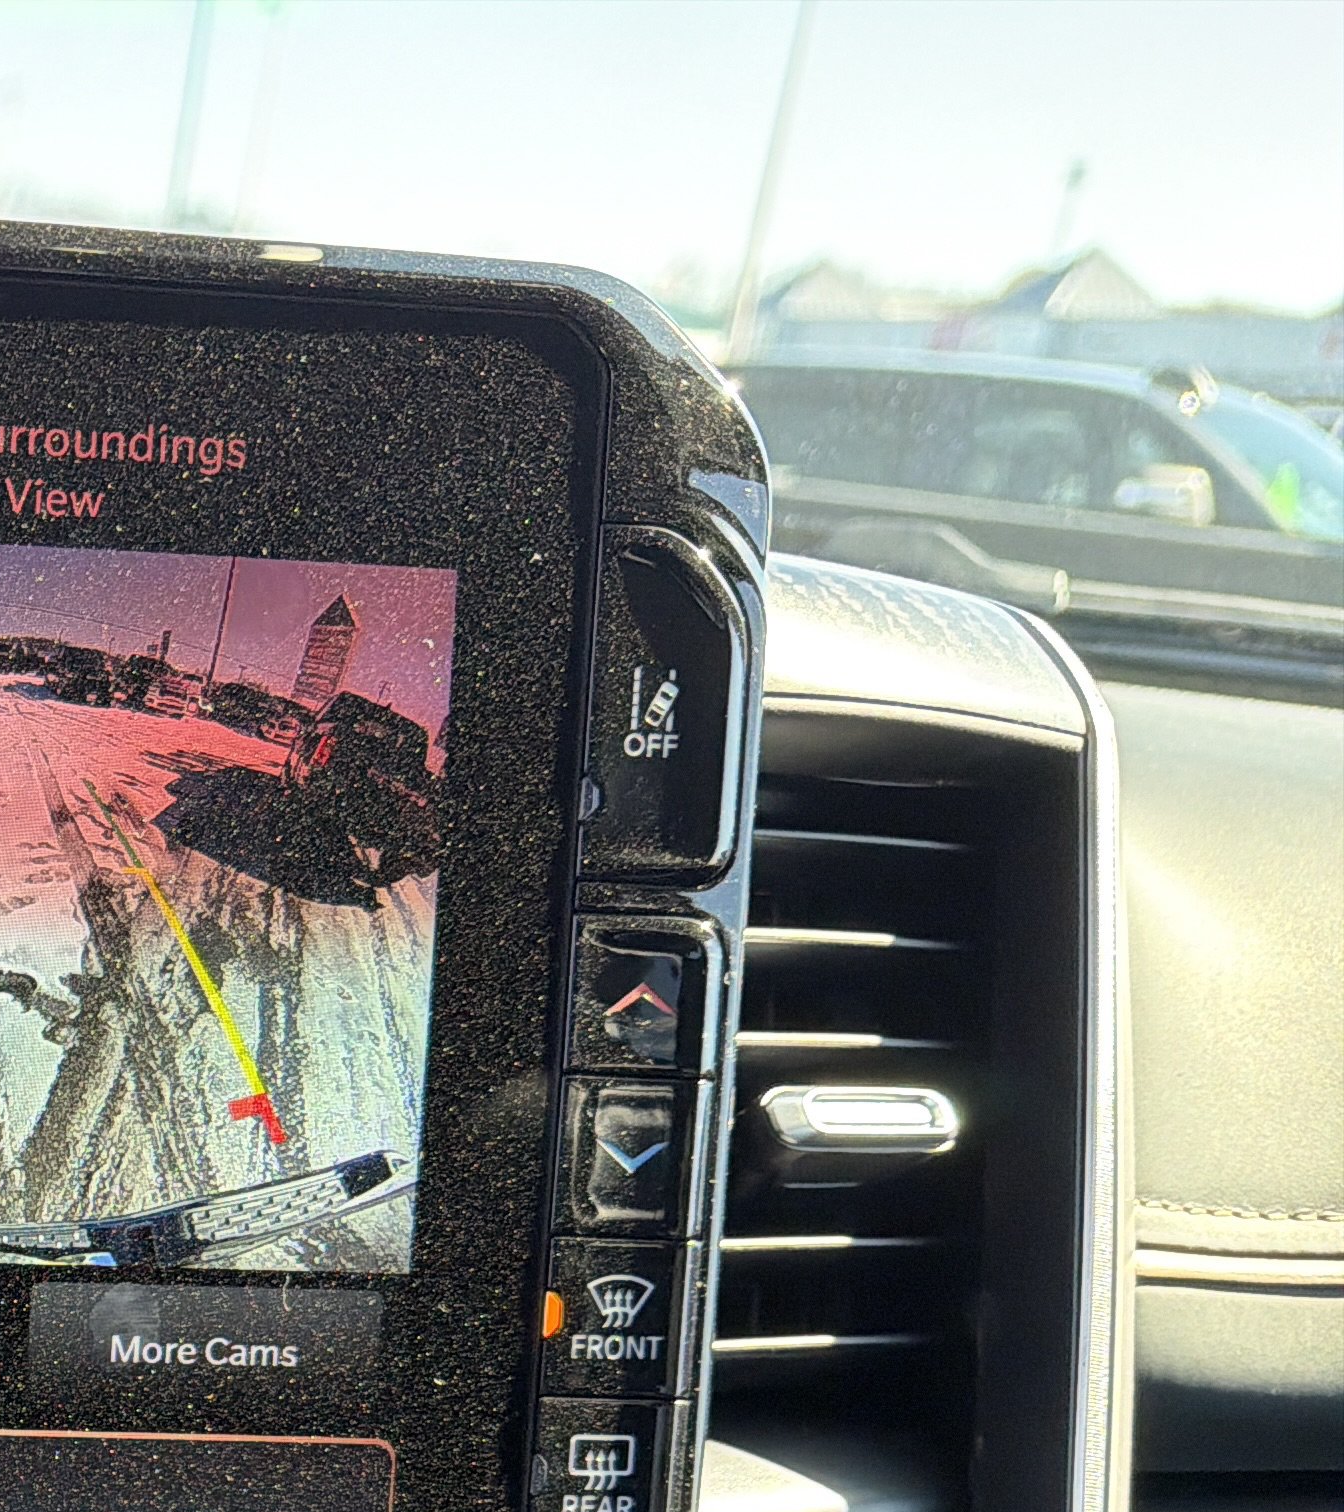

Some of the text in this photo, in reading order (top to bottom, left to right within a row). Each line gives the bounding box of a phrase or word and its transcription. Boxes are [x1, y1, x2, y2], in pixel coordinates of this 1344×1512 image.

[6, 478, 105, 518] View
[624, 732, 680, 759] OFF
[110, 1334, 299, 1369] More Cams
[570, 1334, 664, 1362] FRONT
